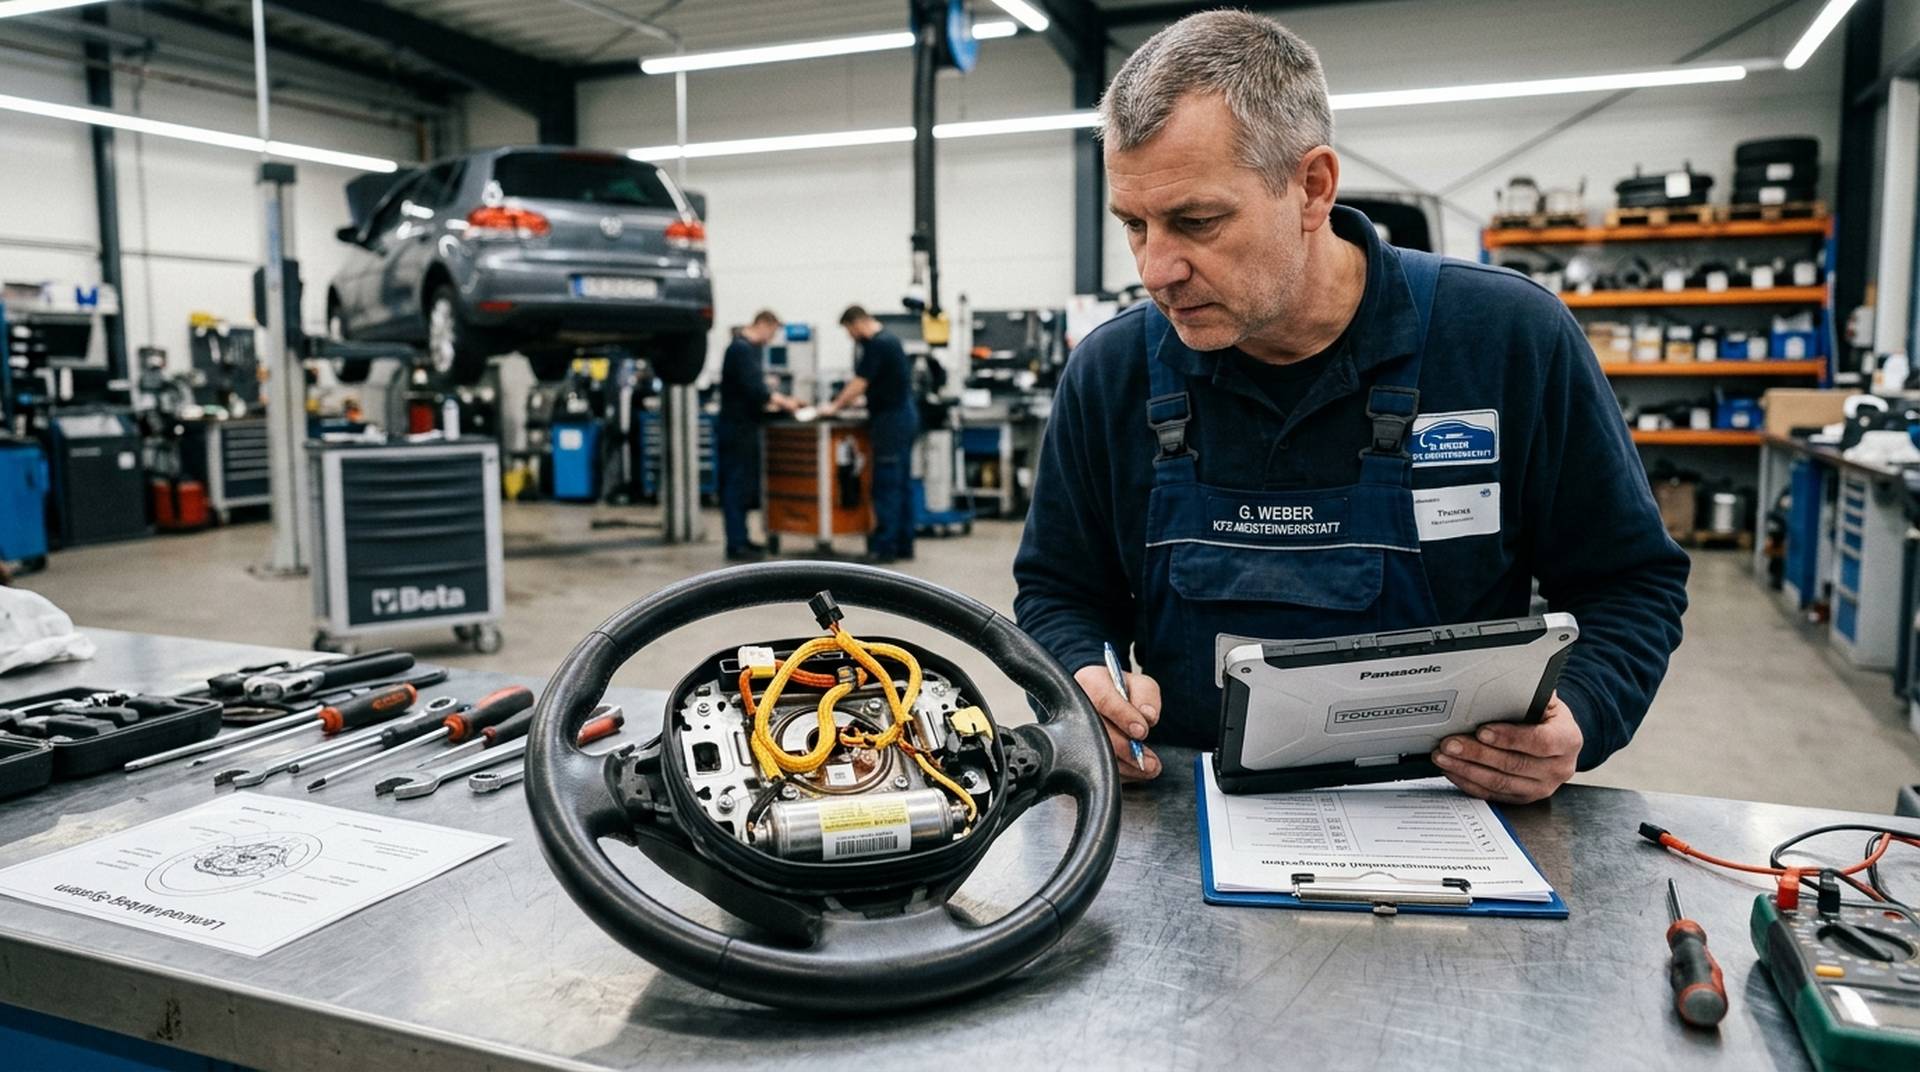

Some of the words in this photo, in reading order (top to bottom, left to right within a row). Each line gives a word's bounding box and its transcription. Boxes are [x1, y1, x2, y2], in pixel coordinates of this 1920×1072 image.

[1238, 505, 1254, 519] G.
[1258, 506, 1314, 520] WEBER
[399, 585, 466, 612] Beta
[1359, 665, 1442, 680] Panasonic
